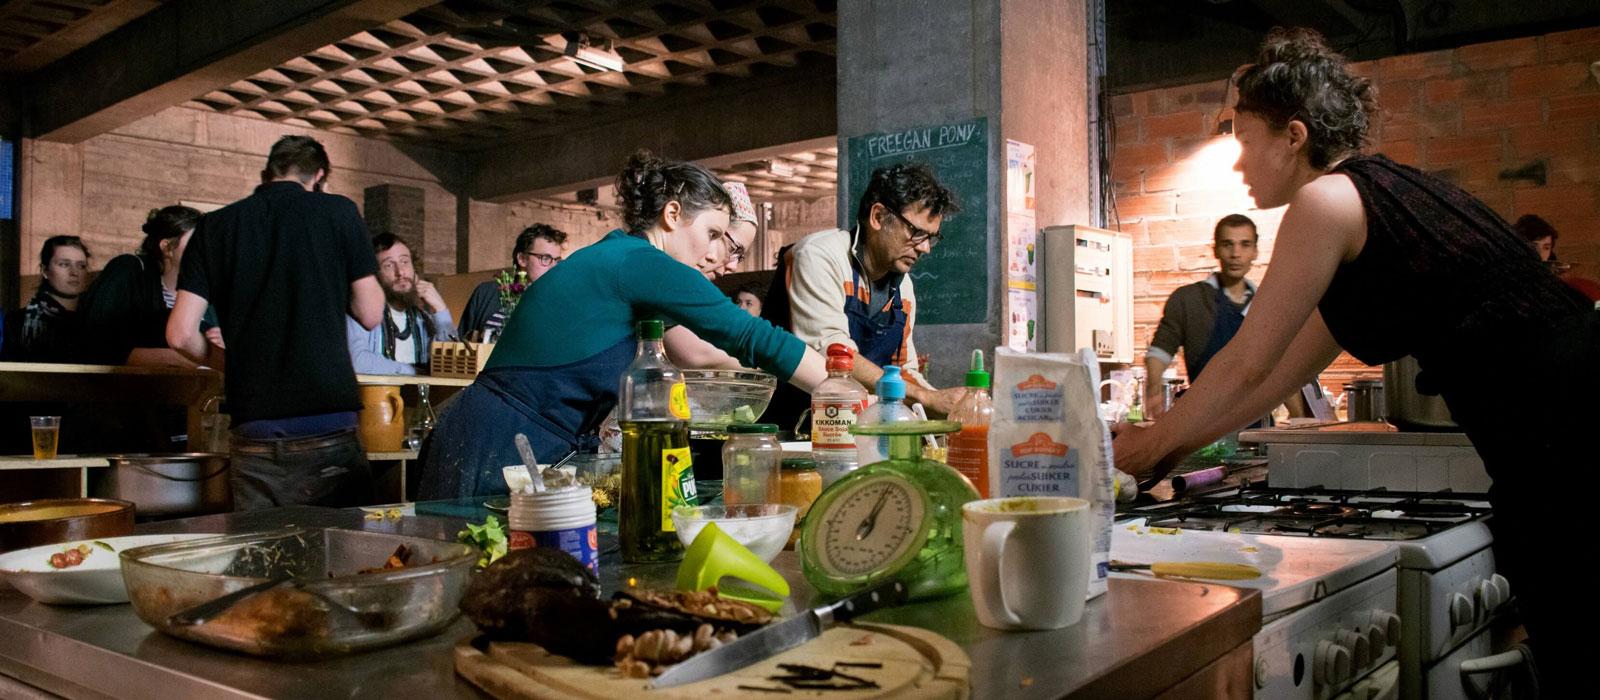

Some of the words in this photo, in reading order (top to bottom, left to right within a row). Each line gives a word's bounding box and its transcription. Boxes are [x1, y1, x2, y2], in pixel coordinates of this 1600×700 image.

[868, 129, 931, 157] FREEGAN
[939, 124, 976, 146] PONY
[1004, 460, 1040, 469] SUCRE
[1031, 471, 1071, 481] SUIKER
[1018, 483, 1060, 492] CUKIER
